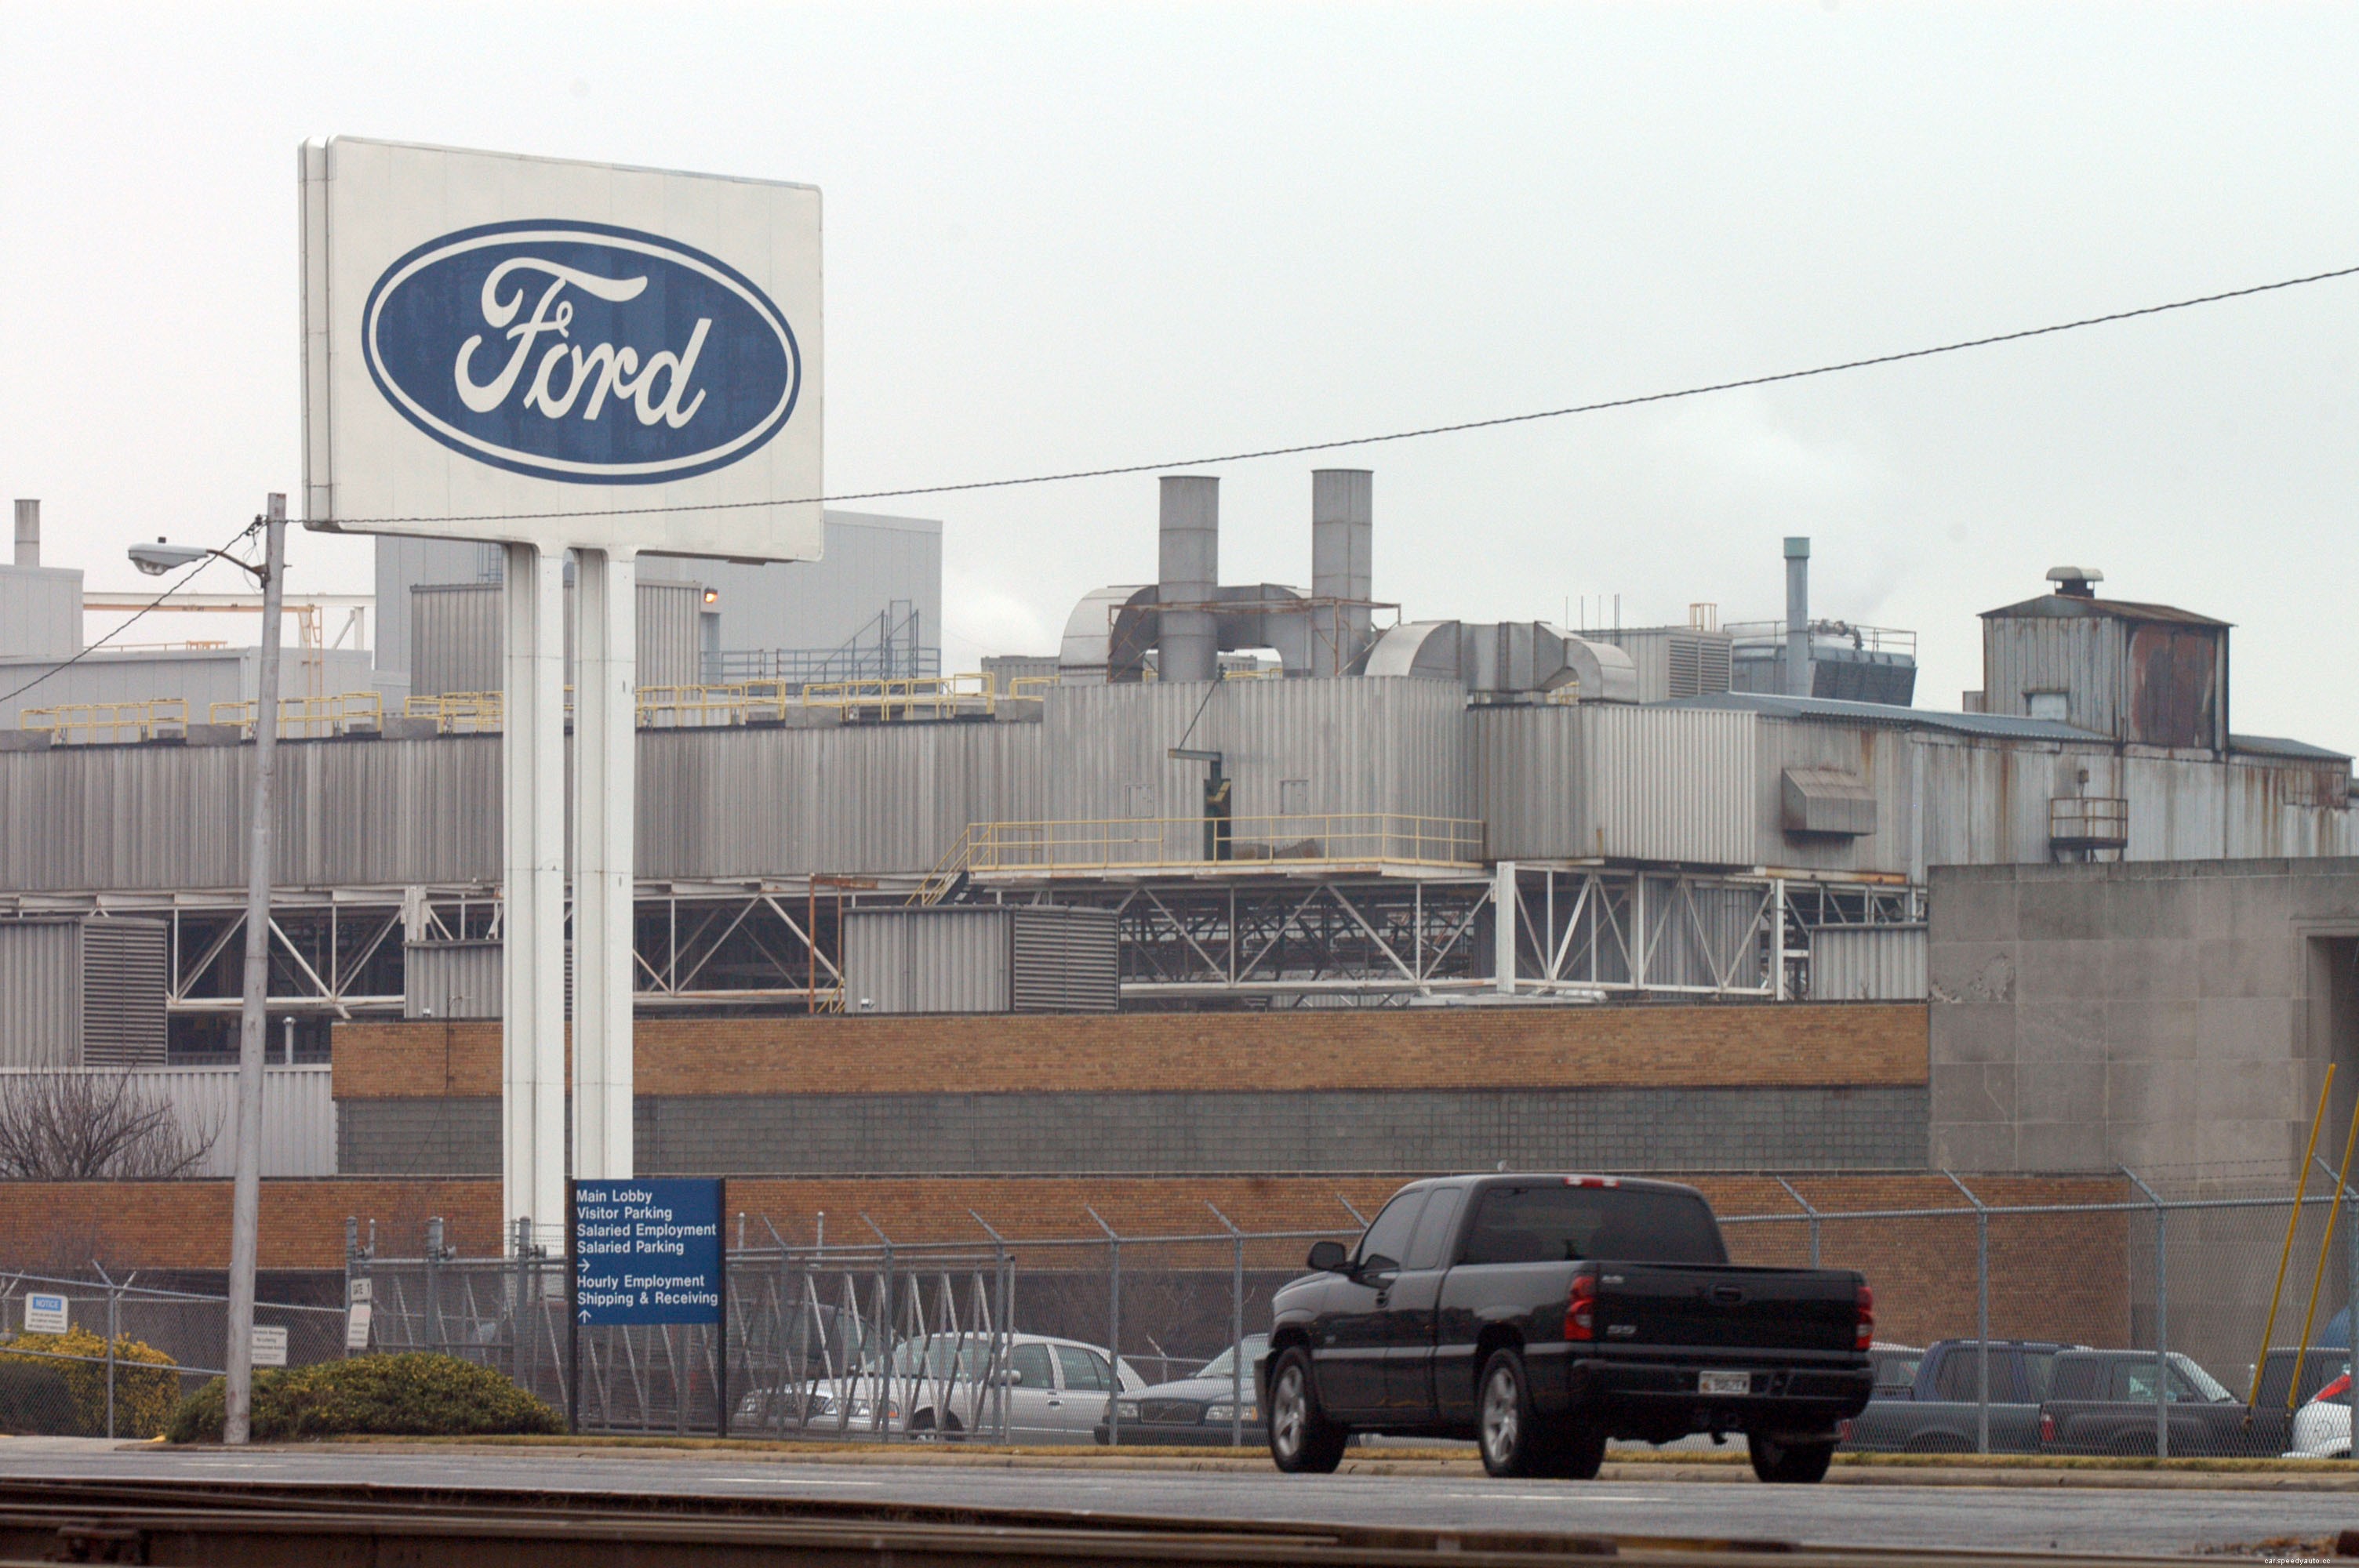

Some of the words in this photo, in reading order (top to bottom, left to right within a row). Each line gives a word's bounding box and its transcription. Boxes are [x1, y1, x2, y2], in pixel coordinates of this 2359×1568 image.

[454, 257, 712, 429] Ford
[576, 1189, 607, 1203] Main
[612, 1189, 652, 1205] Lobby
[577, 1207, 619, 1220] Visitor
[624, 1207, 673, 1221] Parking
[577, 1224, 631, 1237] Salaried
[636, 1224, 717, 1239] Employment
[577, 1241, 631, 1254] Salaried
[636, 1240, 685, 1256] Parking
[577, 1276, 619, 1290] Hourly
[624, 1275, 705, 1290] Employment
[35, 1298, 59, 1309] NOTICE
[577, 1292, 634, 1308] Shipping
[639, 1292, 649, 1305] &
[655, 1291, 718, 1307] Receiving
